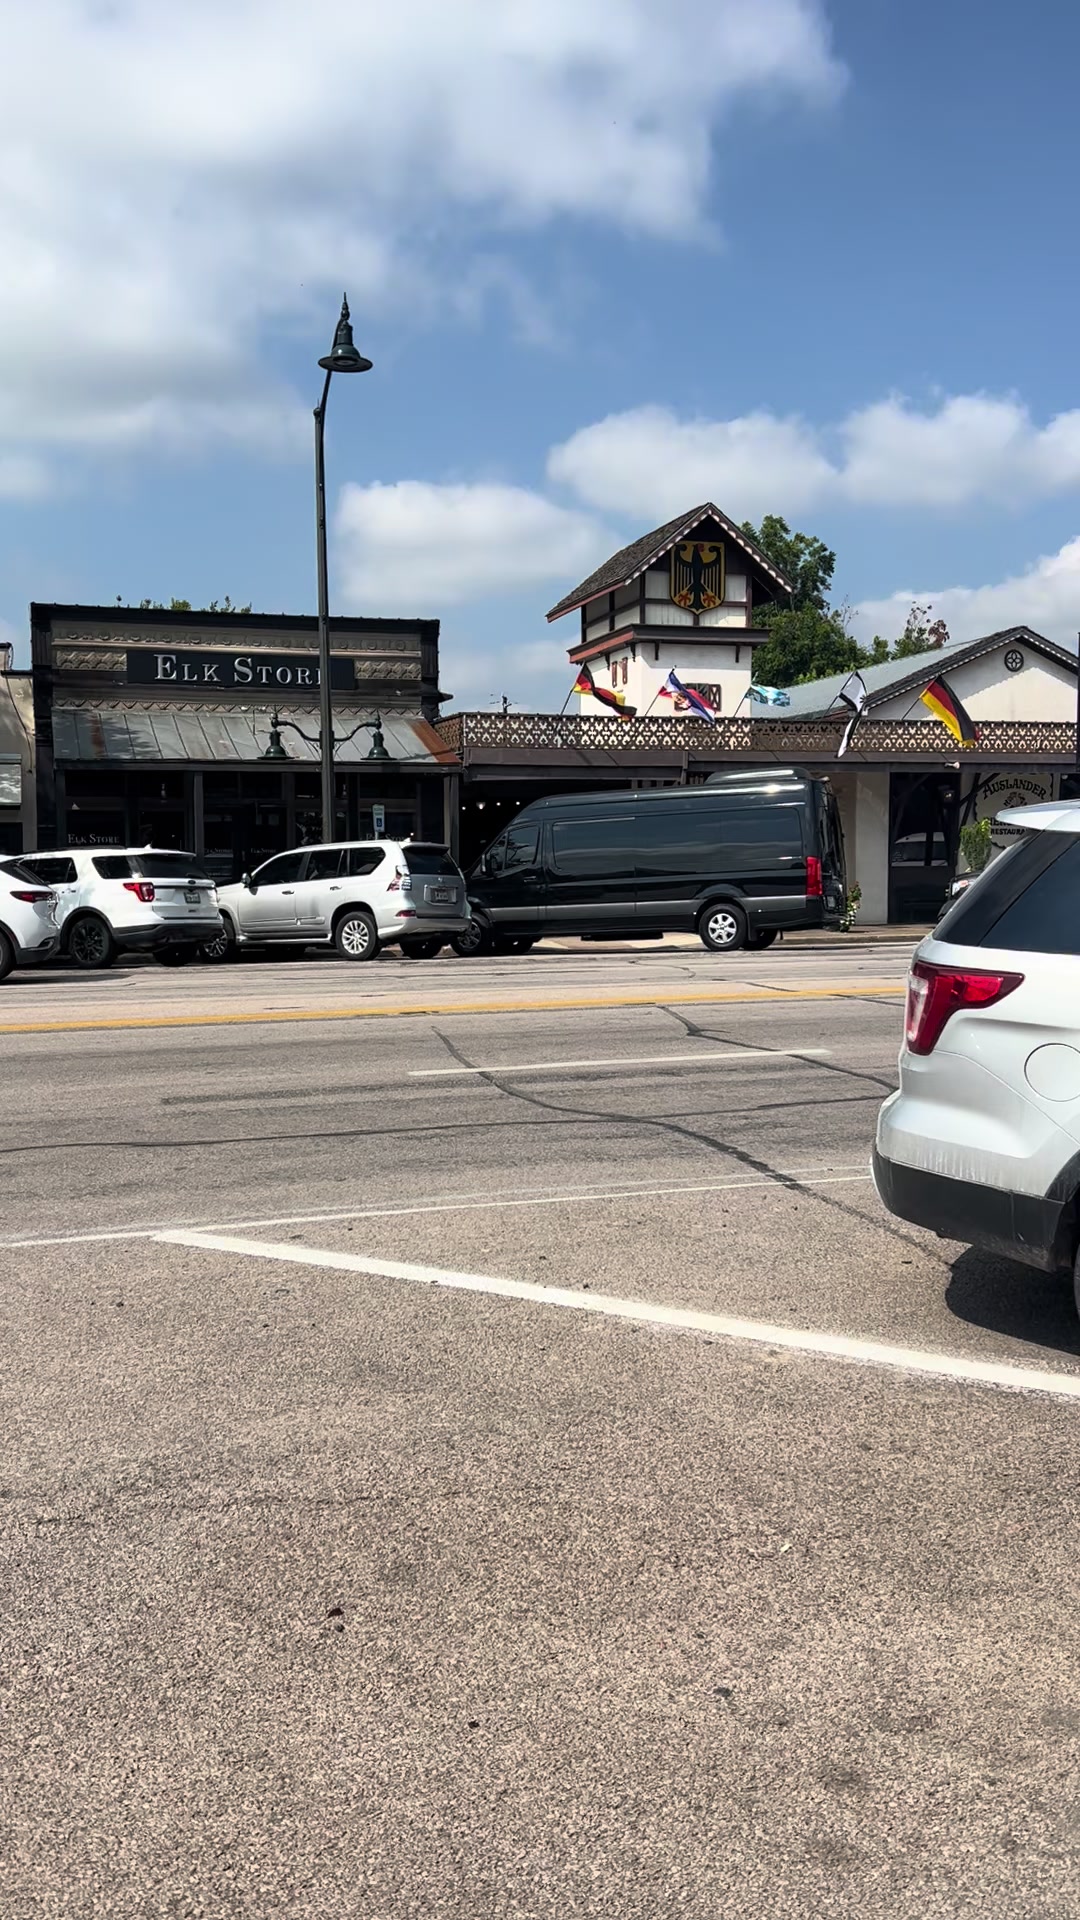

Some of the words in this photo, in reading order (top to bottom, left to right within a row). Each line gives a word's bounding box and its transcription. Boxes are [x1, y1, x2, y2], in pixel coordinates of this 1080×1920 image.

[154, 654, 221, 682] ELK
[234, 657, 321, 684] STOR
[983, 778, 1047, 801] AUSLANDER
